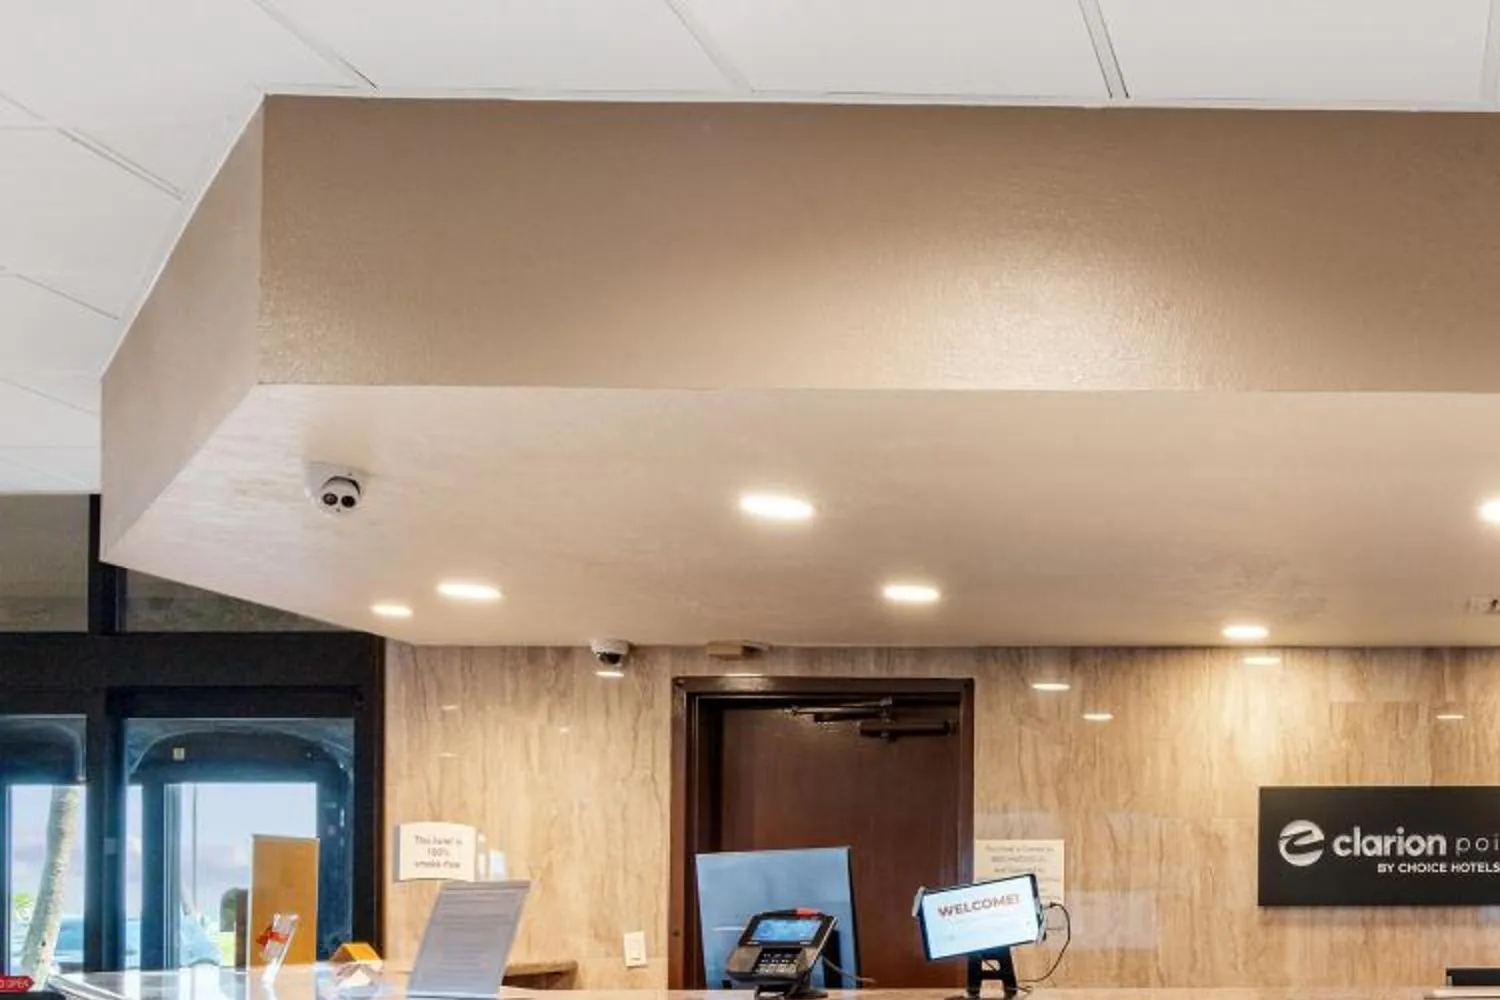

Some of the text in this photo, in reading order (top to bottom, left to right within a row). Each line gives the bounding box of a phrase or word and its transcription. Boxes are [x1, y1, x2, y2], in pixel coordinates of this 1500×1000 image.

[1332, 826, 1447, 857] clarion
[1377, 862, 1500, 873] BY CHOICE HOTELS
[937, 893, 1020, 918] WELCOME!
